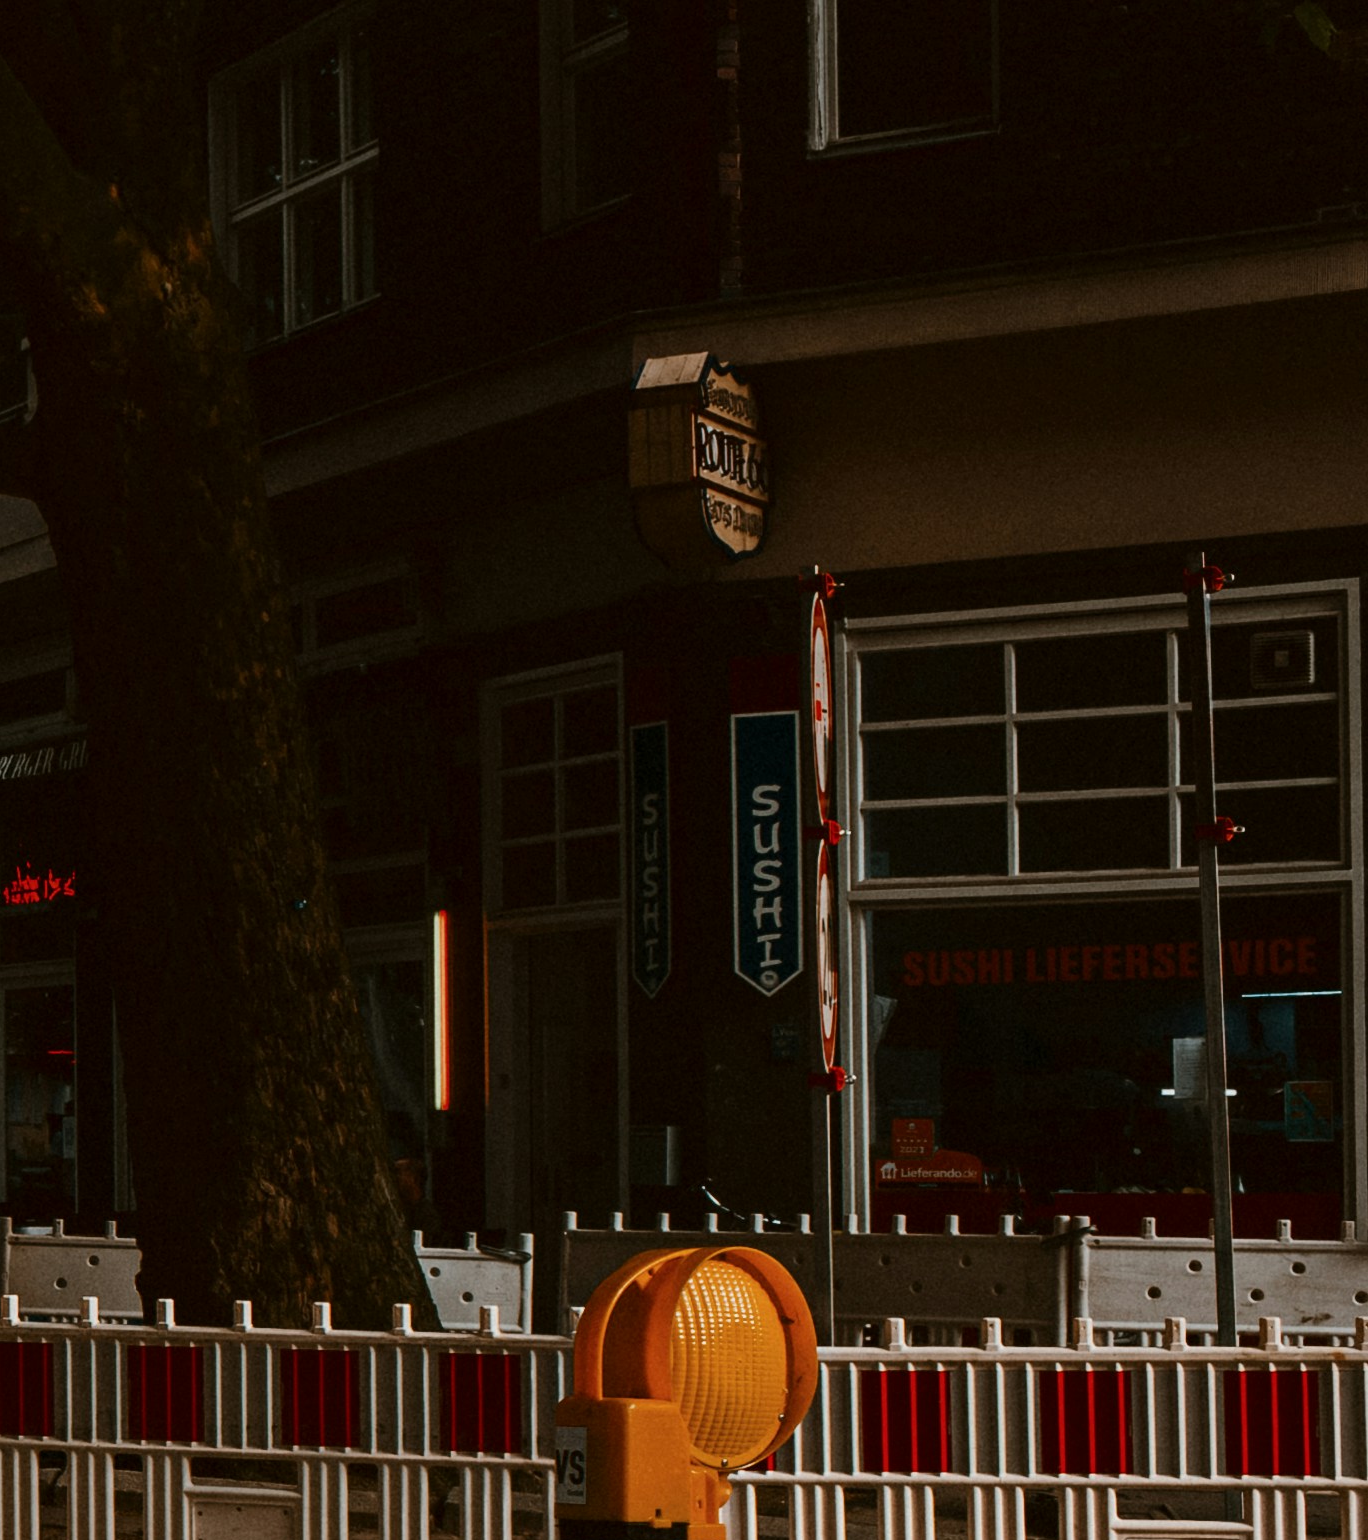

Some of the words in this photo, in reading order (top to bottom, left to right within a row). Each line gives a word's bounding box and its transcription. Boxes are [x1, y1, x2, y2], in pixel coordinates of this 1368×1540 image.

[641, 793, 661, 970] SUSHI
[751, 784, 783, 968] SUSHI
[902, 949, 1015, 988] SUSHI
[1026, 937, 1318, 983] LIEFERSEVICE
[900, 1167, 978, 1179] Lieferando.de
